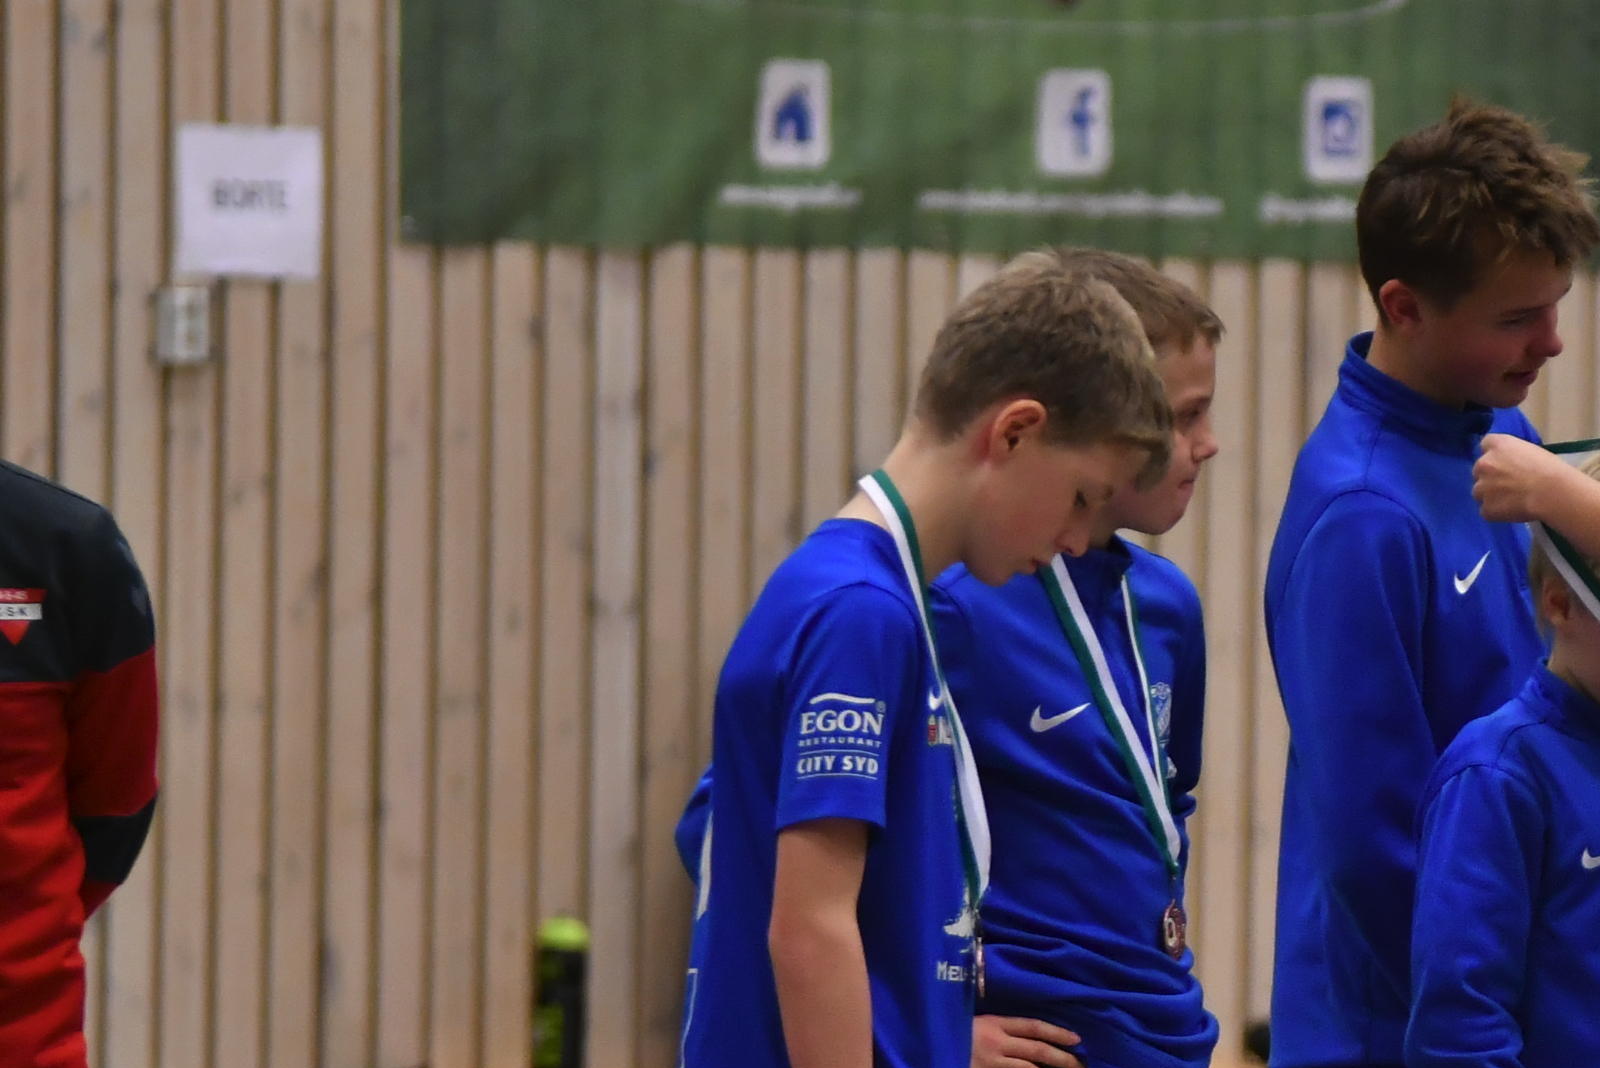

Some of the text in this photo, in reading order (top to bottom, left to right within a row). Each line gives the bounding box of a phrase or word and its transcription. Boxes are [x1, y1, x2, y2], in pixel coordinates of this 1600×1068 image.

[800, 709, 884, 735] EGON
[797, 755, 879, 774] CITY SYD
